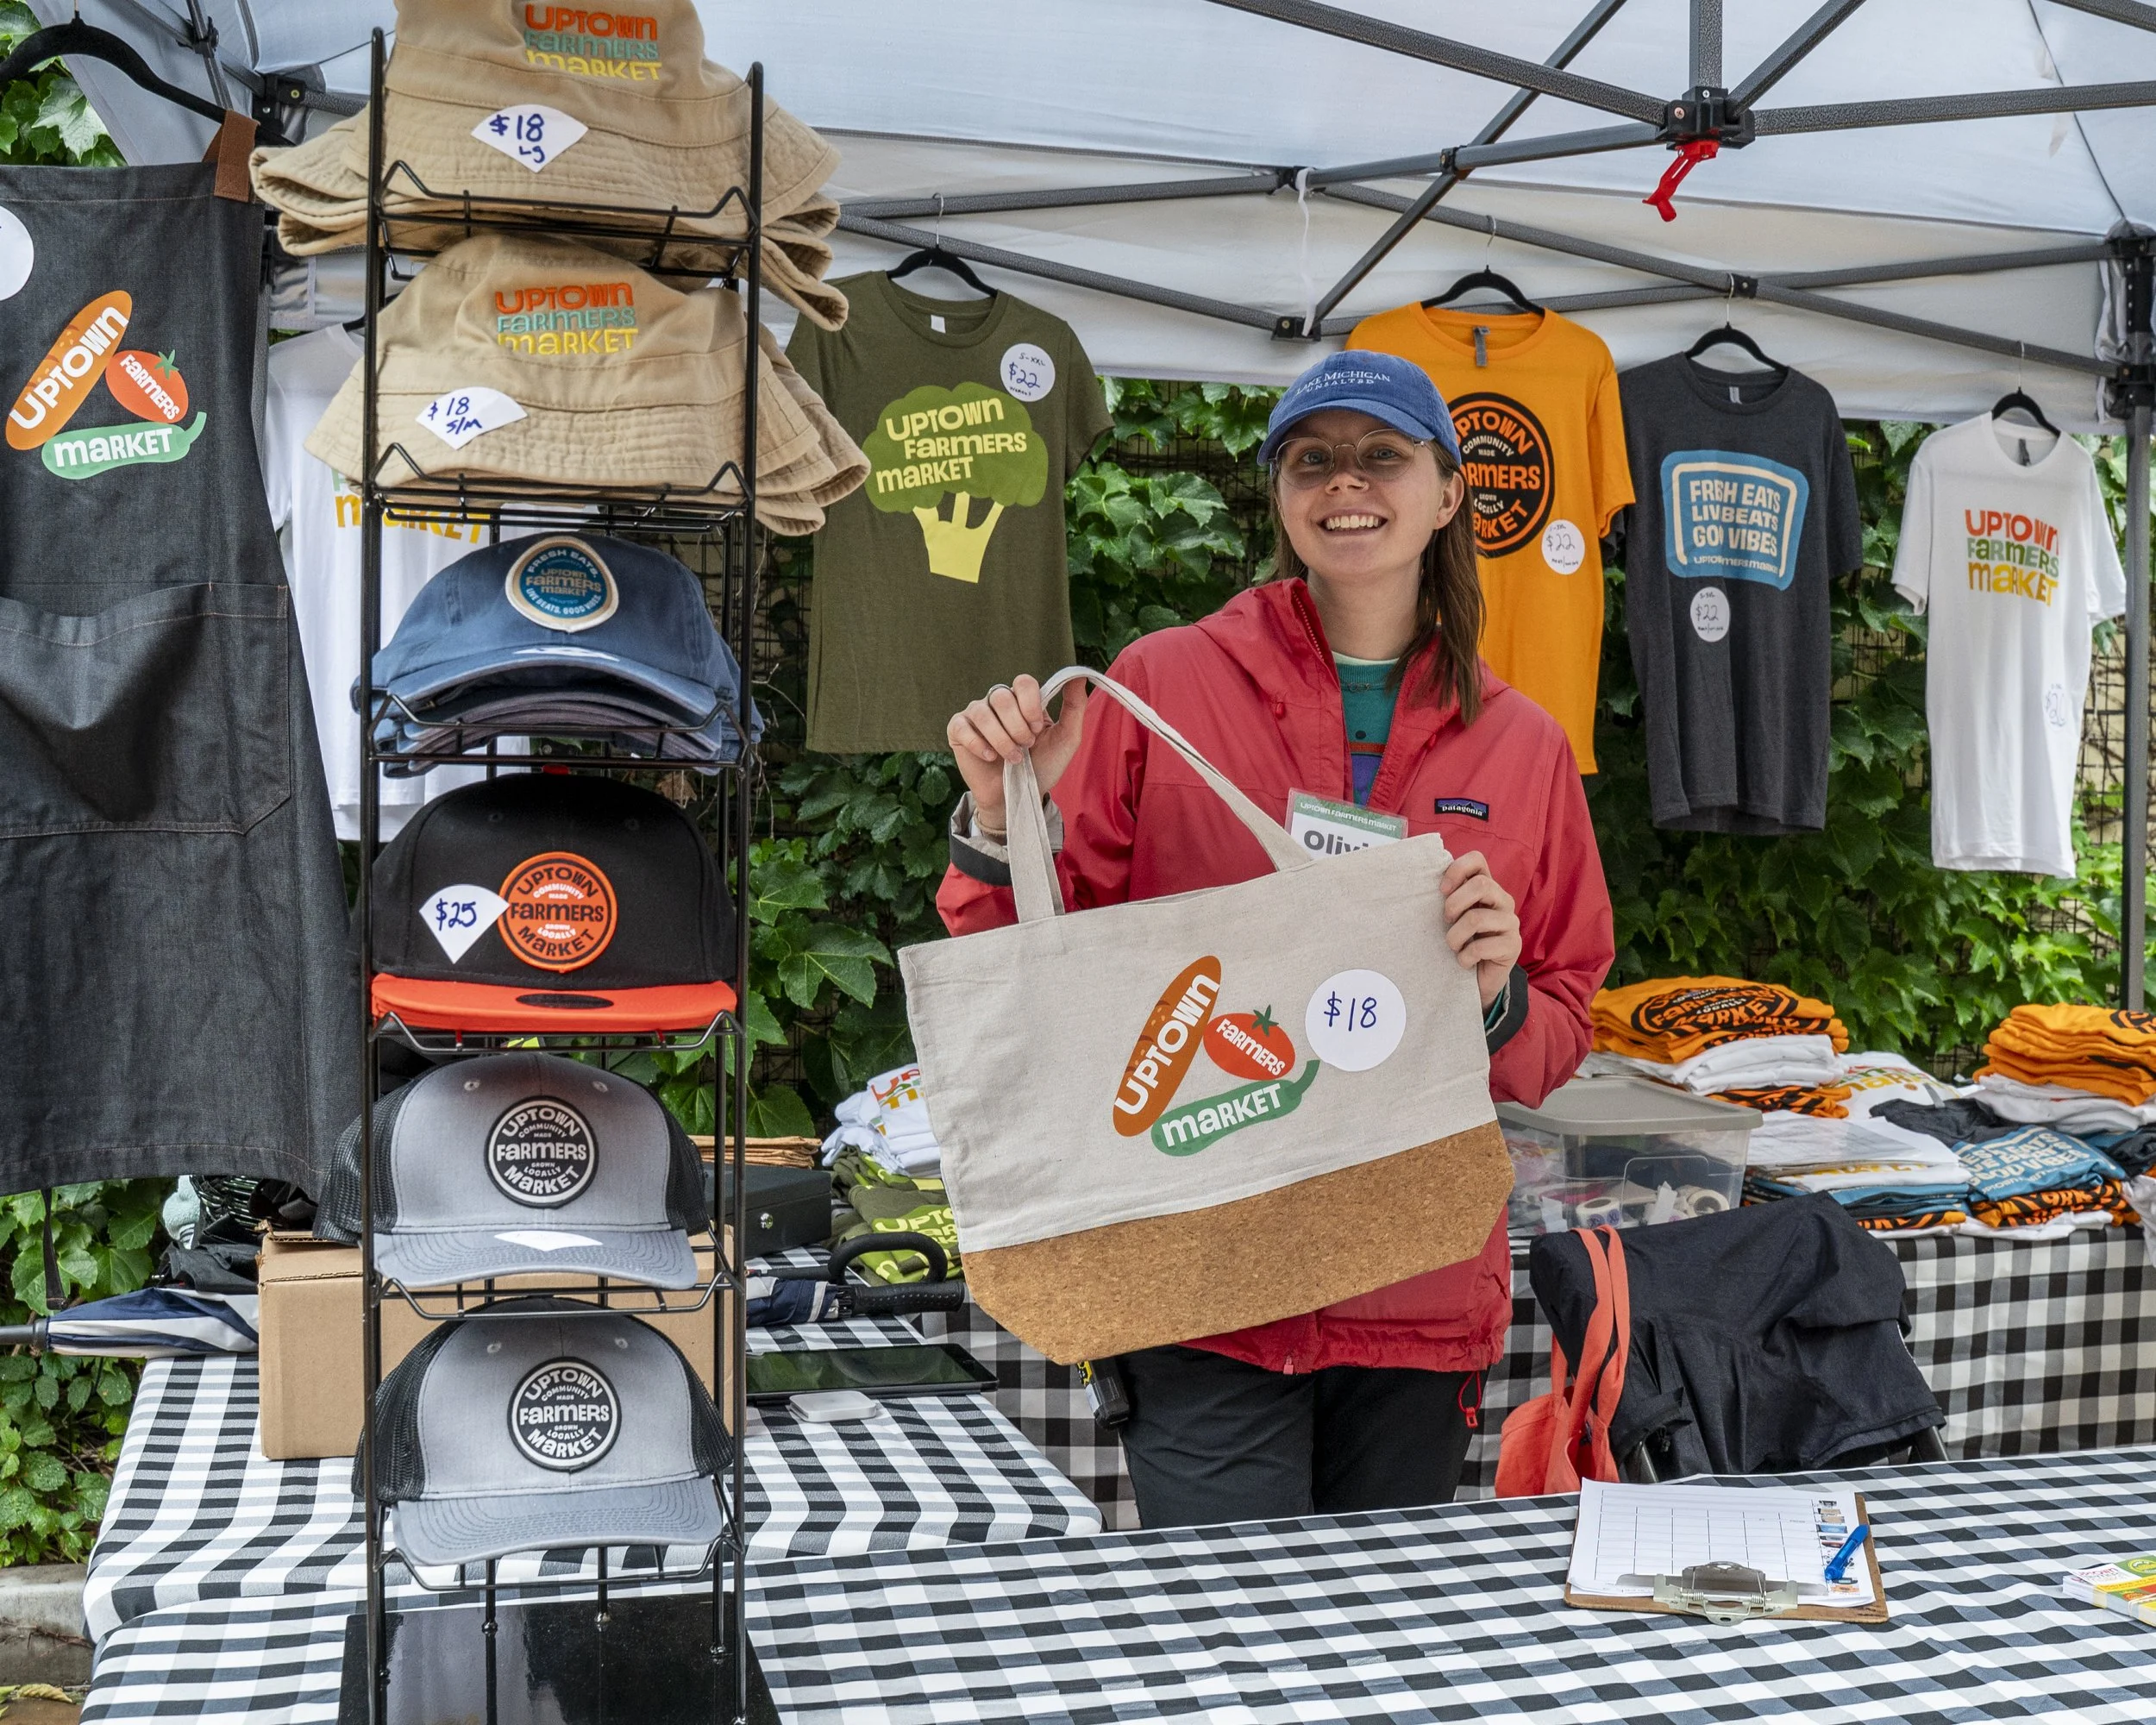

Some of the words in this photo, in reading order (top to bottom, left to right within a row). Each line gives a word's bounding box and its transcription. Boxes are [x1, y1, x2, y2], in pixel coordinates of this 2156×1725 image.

[1009, 361, 1041, 388] $22
[1296, 376, 1322, 396] LAKE
[1324, 370, 1391, 383] MICHIGAN
[1306, 378, 1375, 392] UNSALTED
[1456, 411, 1534, 455] PTOWN
[1462, 435, 1514, 457] COMMUNITY
[1478, 448, 1495, 457] MADE
[1474, 499, 1505, 514] LOCALLY
[1741, 483, 1781, 513] EATS
[1473, 499, 1528, 539] aRKET
[1691, 505, 1720, 522] LIV
[1720, 506, 1778, 531] BEATS
[1546, 533, 1576, 552] $22
[1728, 528, 1777, 557] VIBES
[1695, 604, 1719, 621] $22
[1441, 805, 1483, 818] patagonia
[517, 867, 599, 898] UPTOWN
[533, 882, 586, 900] COMMUNITY
[436, 898, 477, 932] $25
[536, 928, 576, 939] LOCALLY
[1323, 991, 1377, 1032] $18
[502, 1107, 580, 1137] UPTOWN
[518, 1123, 567, 1138] COMMUNITY
[524, 1165, 561, 1176] LOCALLY
[524, 1369, 603, 1401] UPTOWN
[542, 1385, 590, 1402] COMMUNITY
[547, 1428, 584, 1440] LOCALLY
